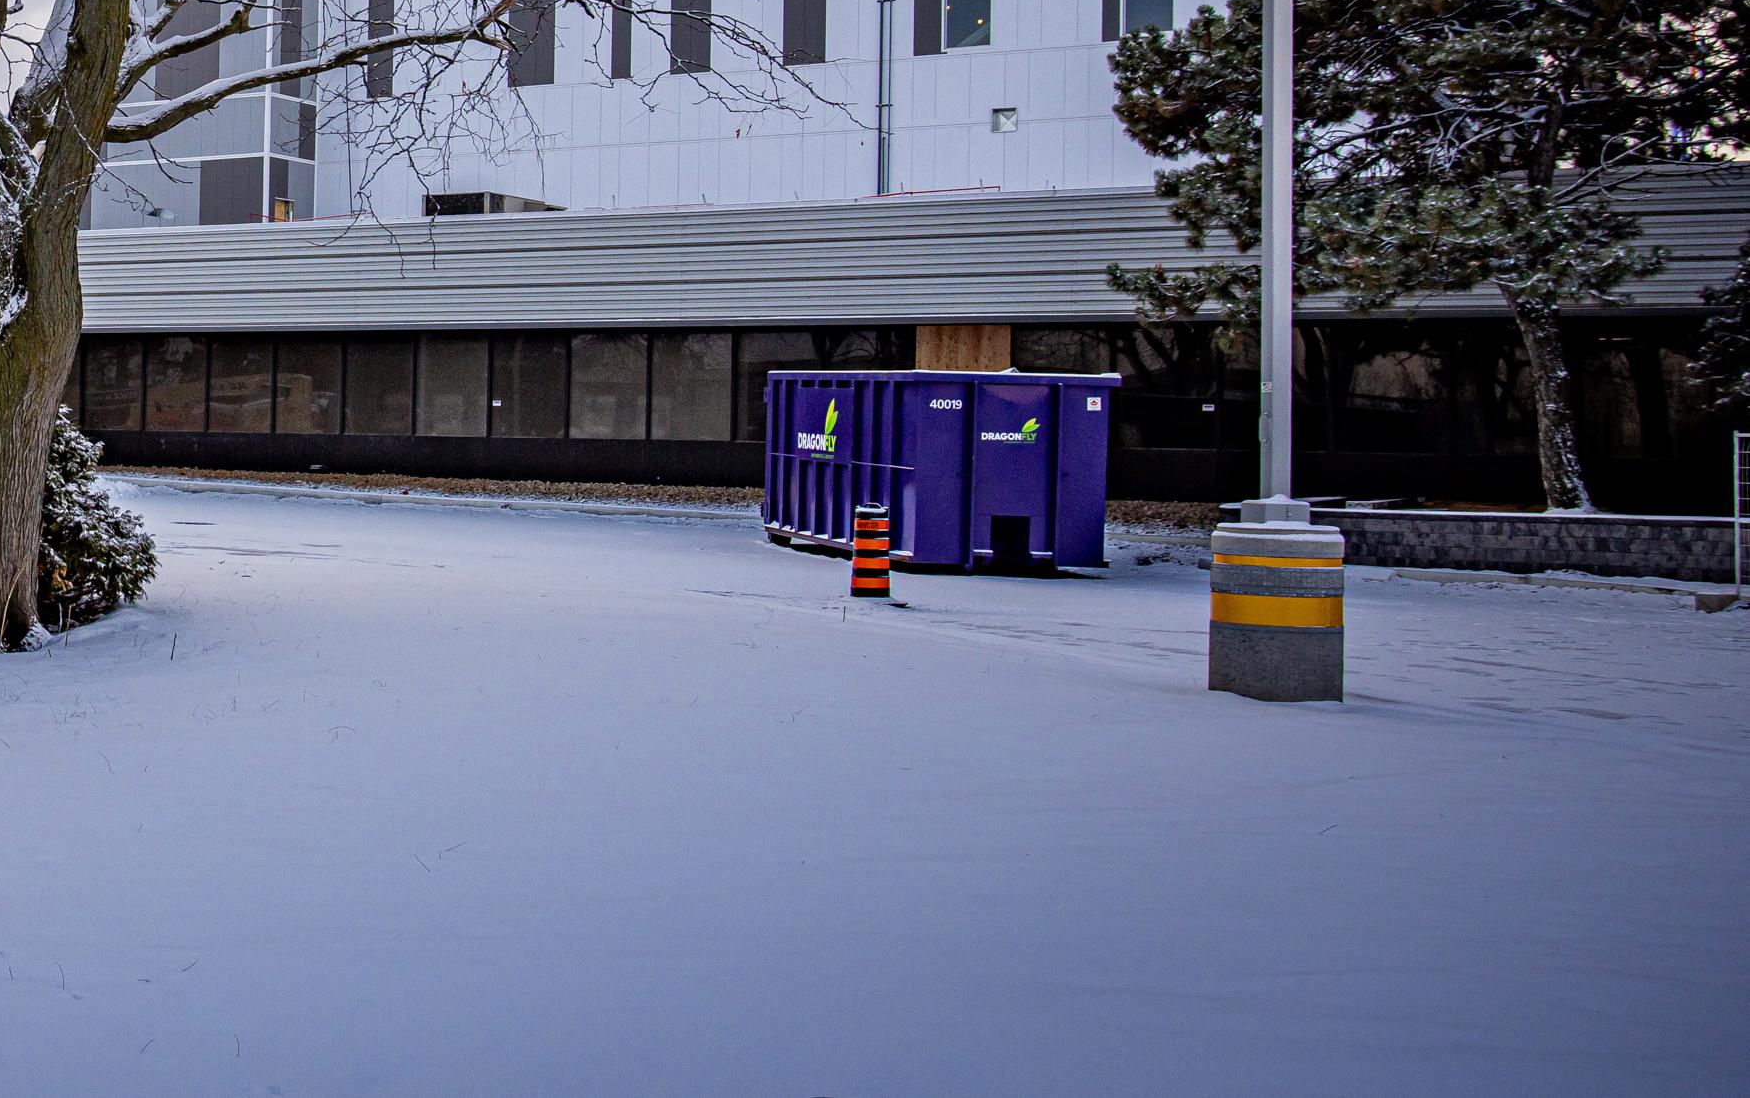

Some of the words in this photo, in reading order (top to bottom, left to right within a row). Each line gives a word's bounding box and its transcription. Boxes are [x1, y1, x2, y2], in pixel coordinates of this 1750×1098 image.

[929, 399, 963, 410] 40019
[797, 432, 837, 452] DRAGONFLY
[980, 432, 1037, 441] DRAGONFLY
